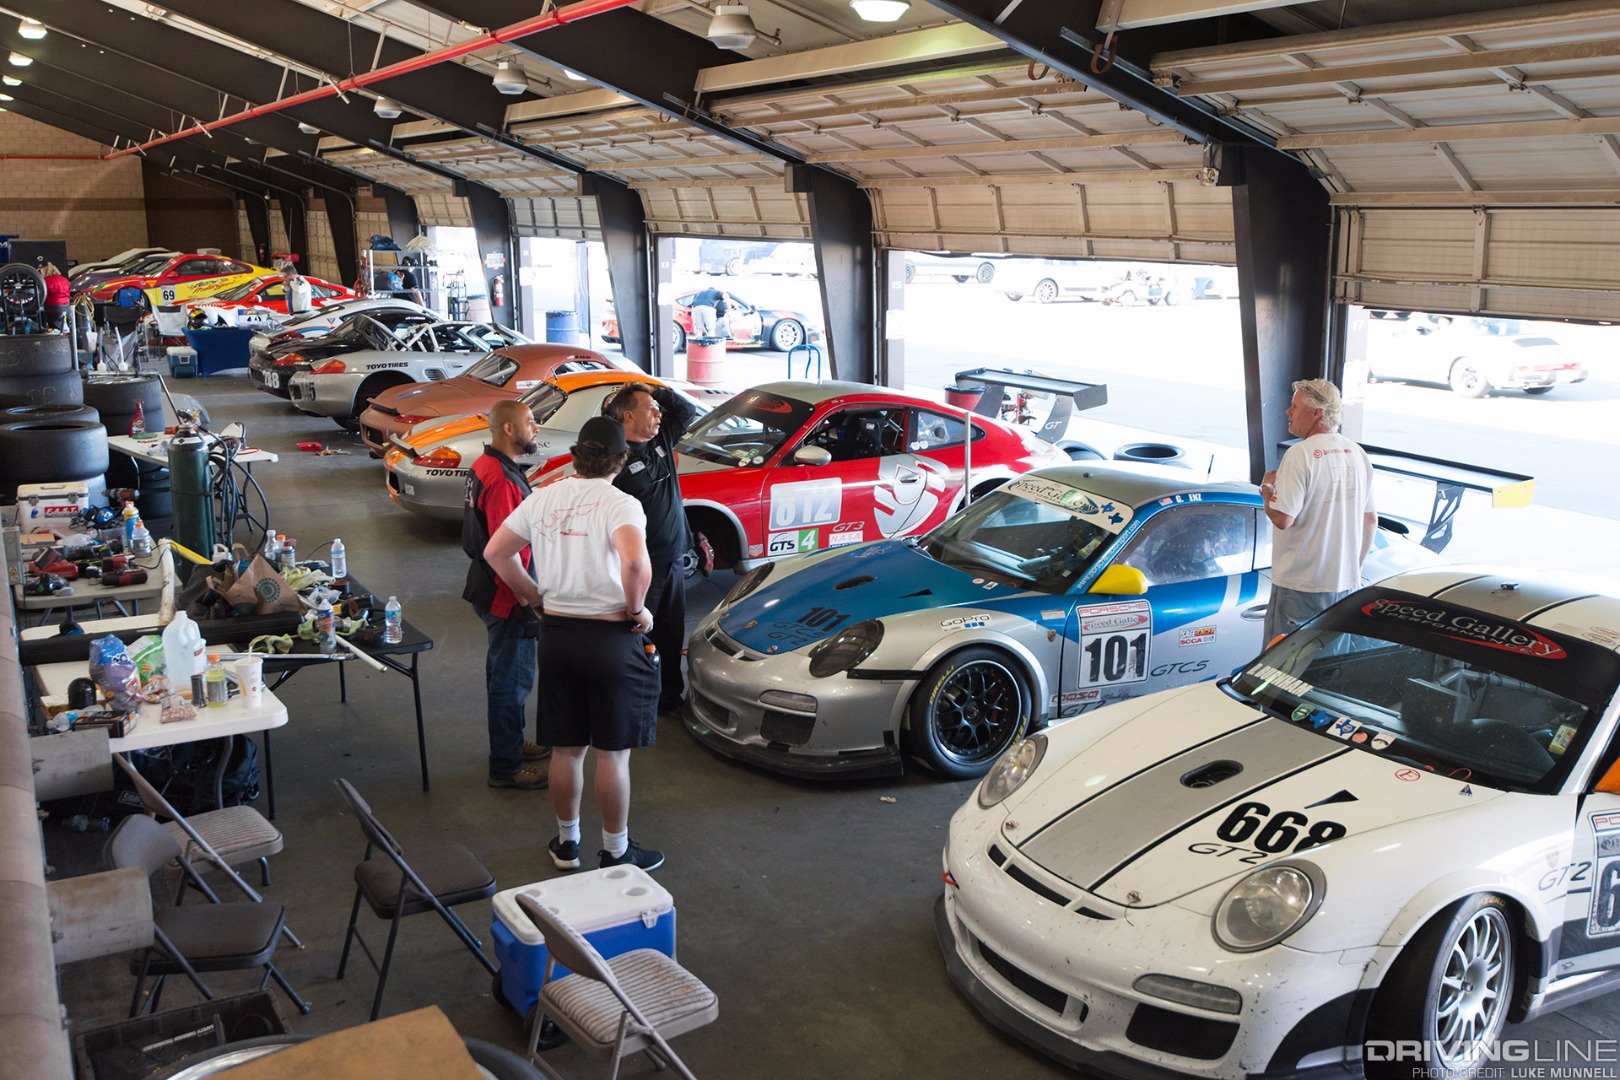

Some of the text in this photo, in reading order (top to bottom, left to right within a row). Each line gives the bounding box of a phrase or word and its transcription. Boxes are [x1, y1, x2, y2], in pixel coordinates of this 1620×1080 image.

[162, 290, 175, 301] 69
[387, 361, 409, 369] TIRES
[1045, 420, 1063, 431] GT
[426, 468, 455, 477] TOYO
[832, 521, 865, 532] GT3
[769, 540, 796, 552] GTS
[801, 530, 816, 550] 4
[1080, 602, 1148, 615] PORSCHE
[795, 607, 852, 632] 101
[939, 614, 990, 628] GoPro
[1370, 599, 1447, 623] Speed
[1451, 615, 1562, 657] Gallery
[1180, 637, 1203, 646] SCCA
[1386, 612, 1536, 655] PERFORMANCE
[1085, 633, 1148, 683] 101
[1151, 659, 1211, 677] GTC5
[929, 664, 955, 705] PIRELLI
[1216, 801, 1348, 854] 668
[1188, 842, 1268, 865] GT2
[1538, 861, 1593, 891] GT2
